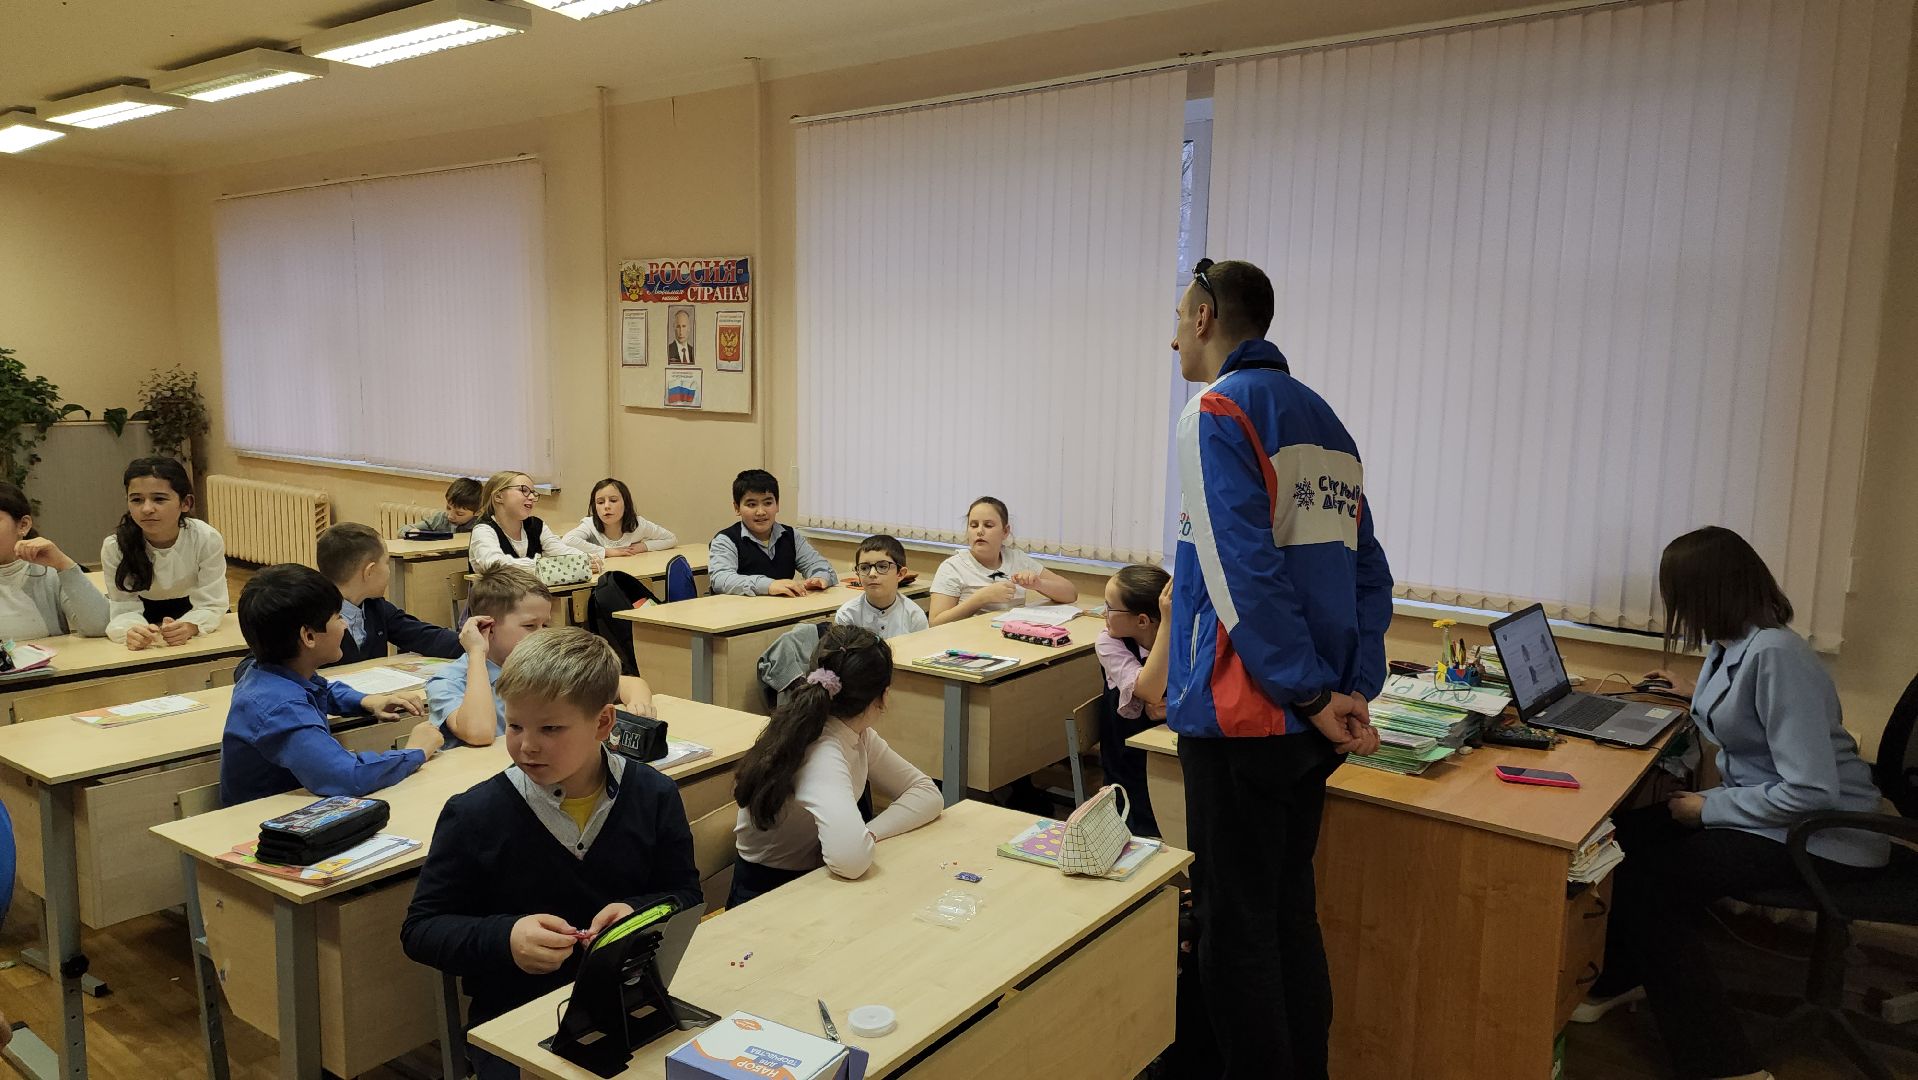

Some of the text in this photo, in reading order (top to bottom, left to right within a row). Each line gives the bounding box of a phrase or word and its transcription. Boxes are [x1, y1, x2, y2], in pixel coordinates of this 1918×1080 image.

[686, 286, 749, 301] СТРАНА!
[750, 1047, 798, 1066] ТВОРЧЕСТВА
[736, 1060, 779, 1078] НАБОР
